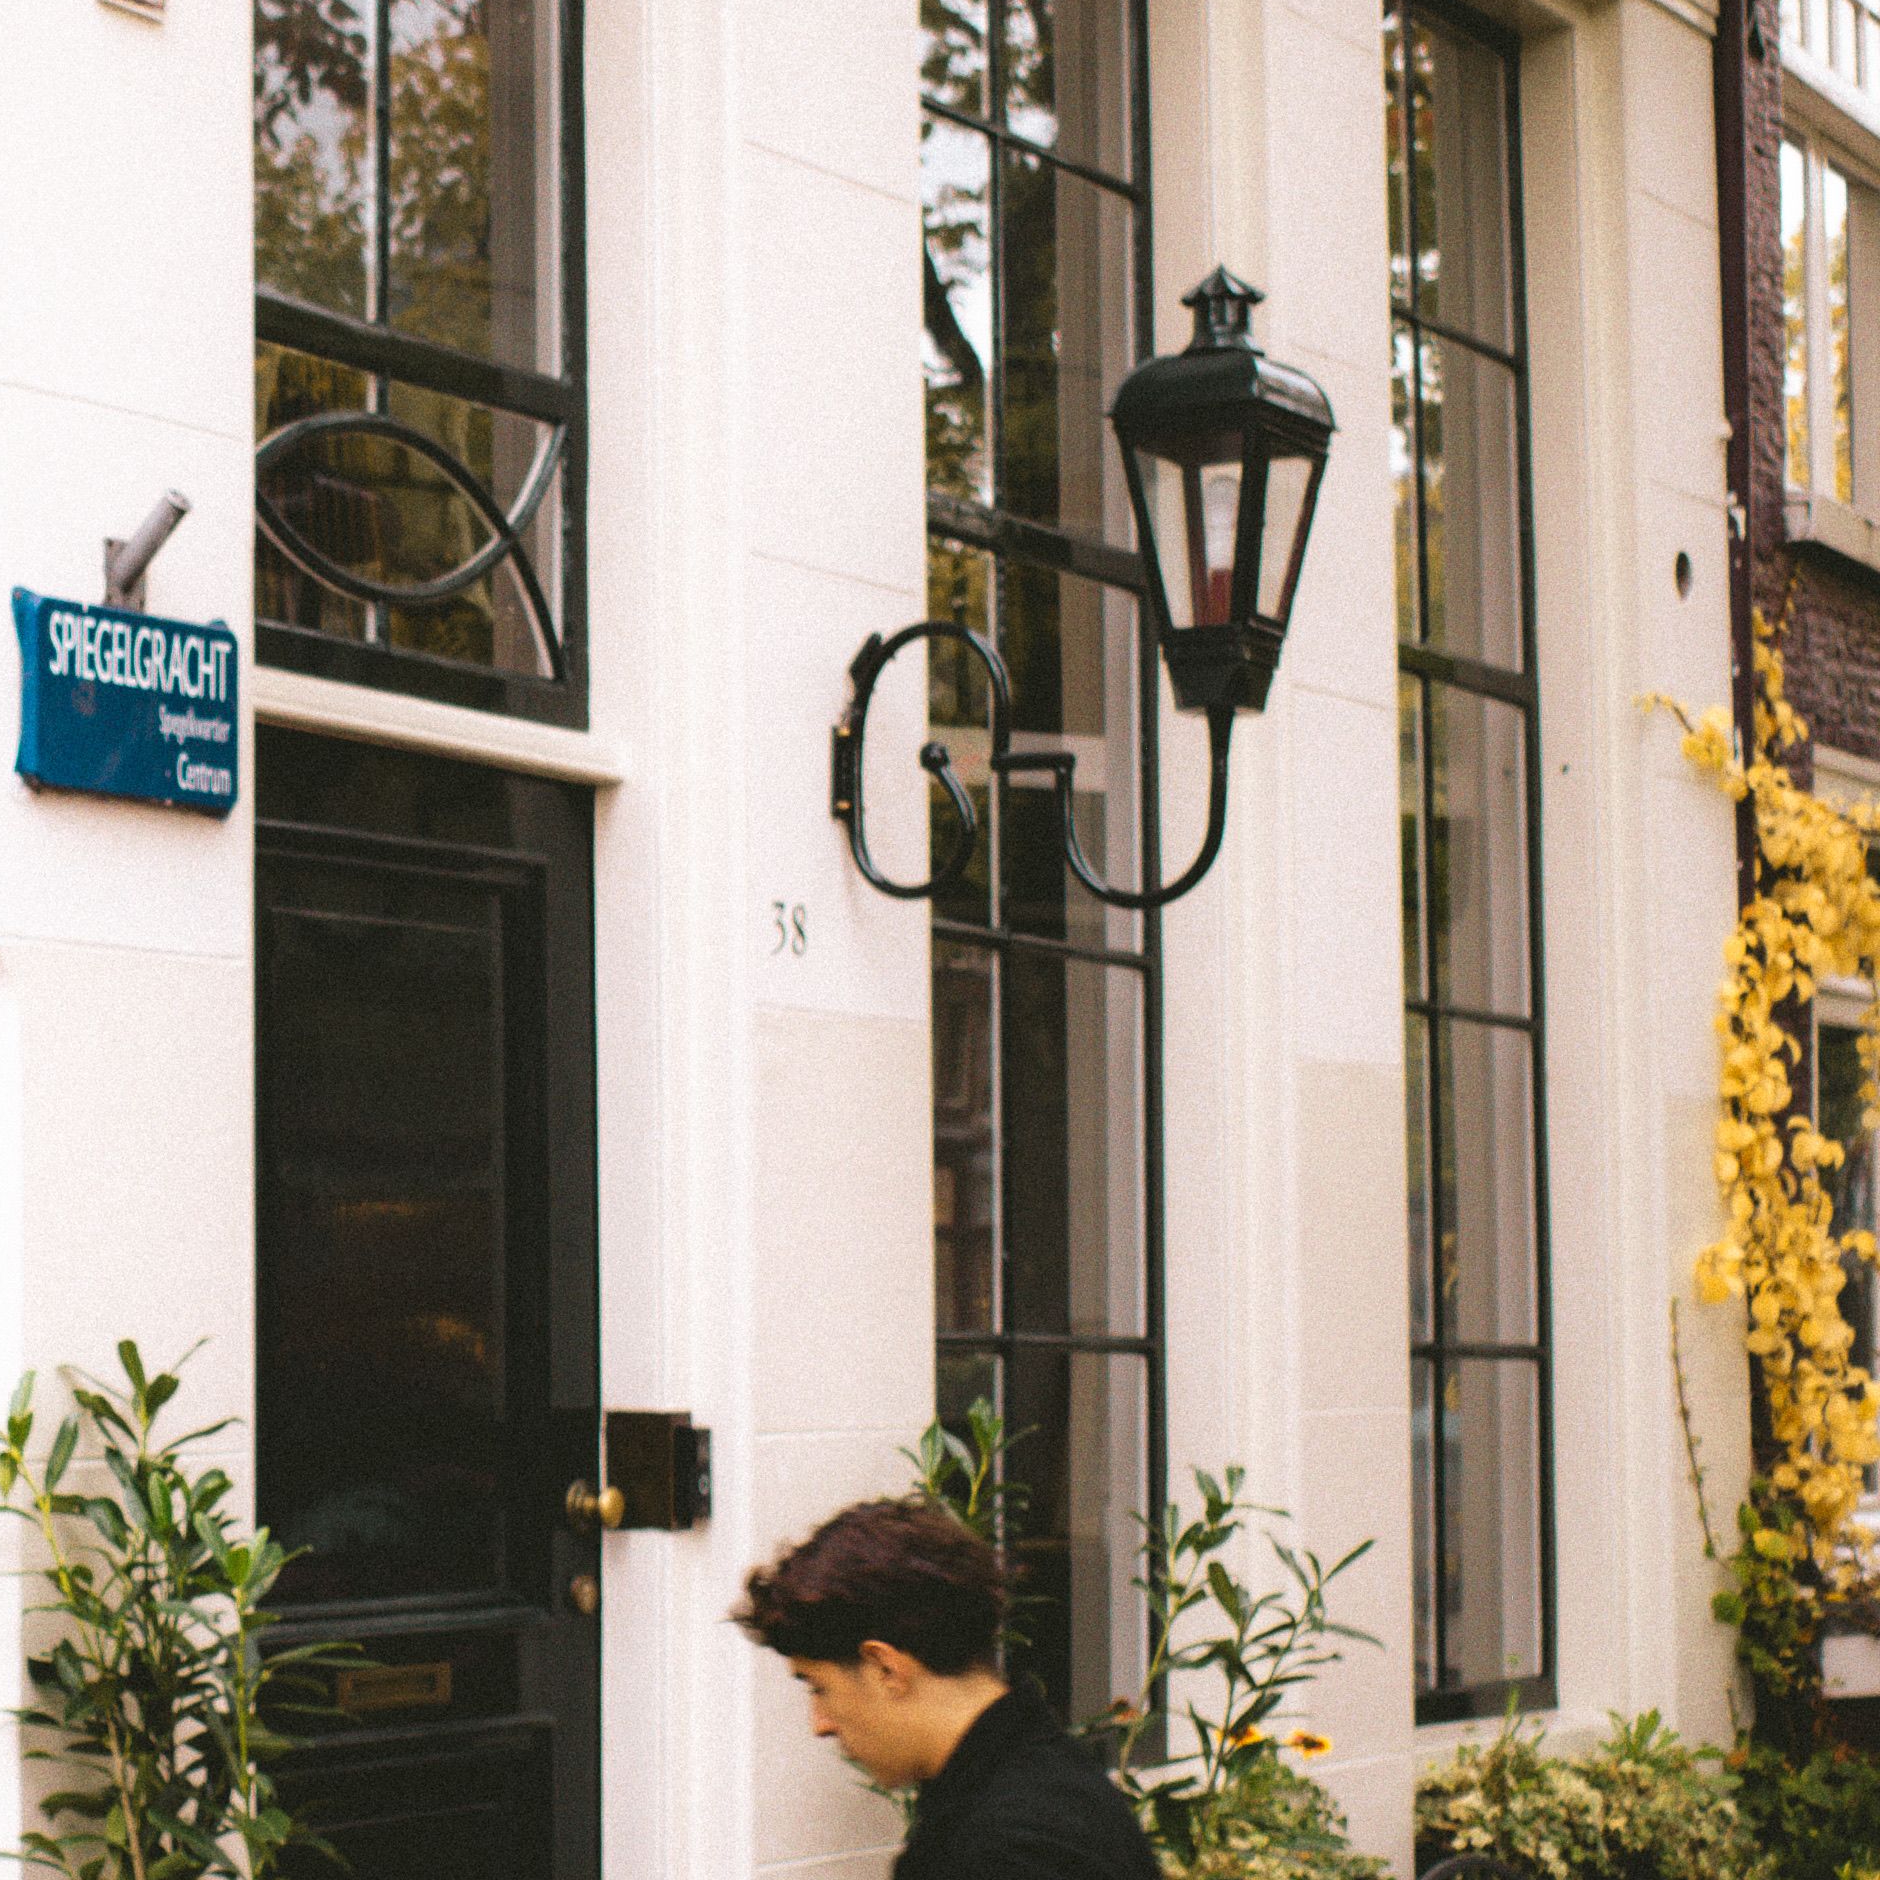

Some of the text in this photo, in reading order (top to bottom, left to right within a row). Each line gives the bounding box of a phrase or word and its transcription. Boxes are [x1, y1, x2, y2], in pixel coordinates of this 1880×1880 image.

[49, 610, 232, 702] SPIEGELGRACHT
[177, 752, 231, 796] Centrum
[771, 901, 807, 957] 38
